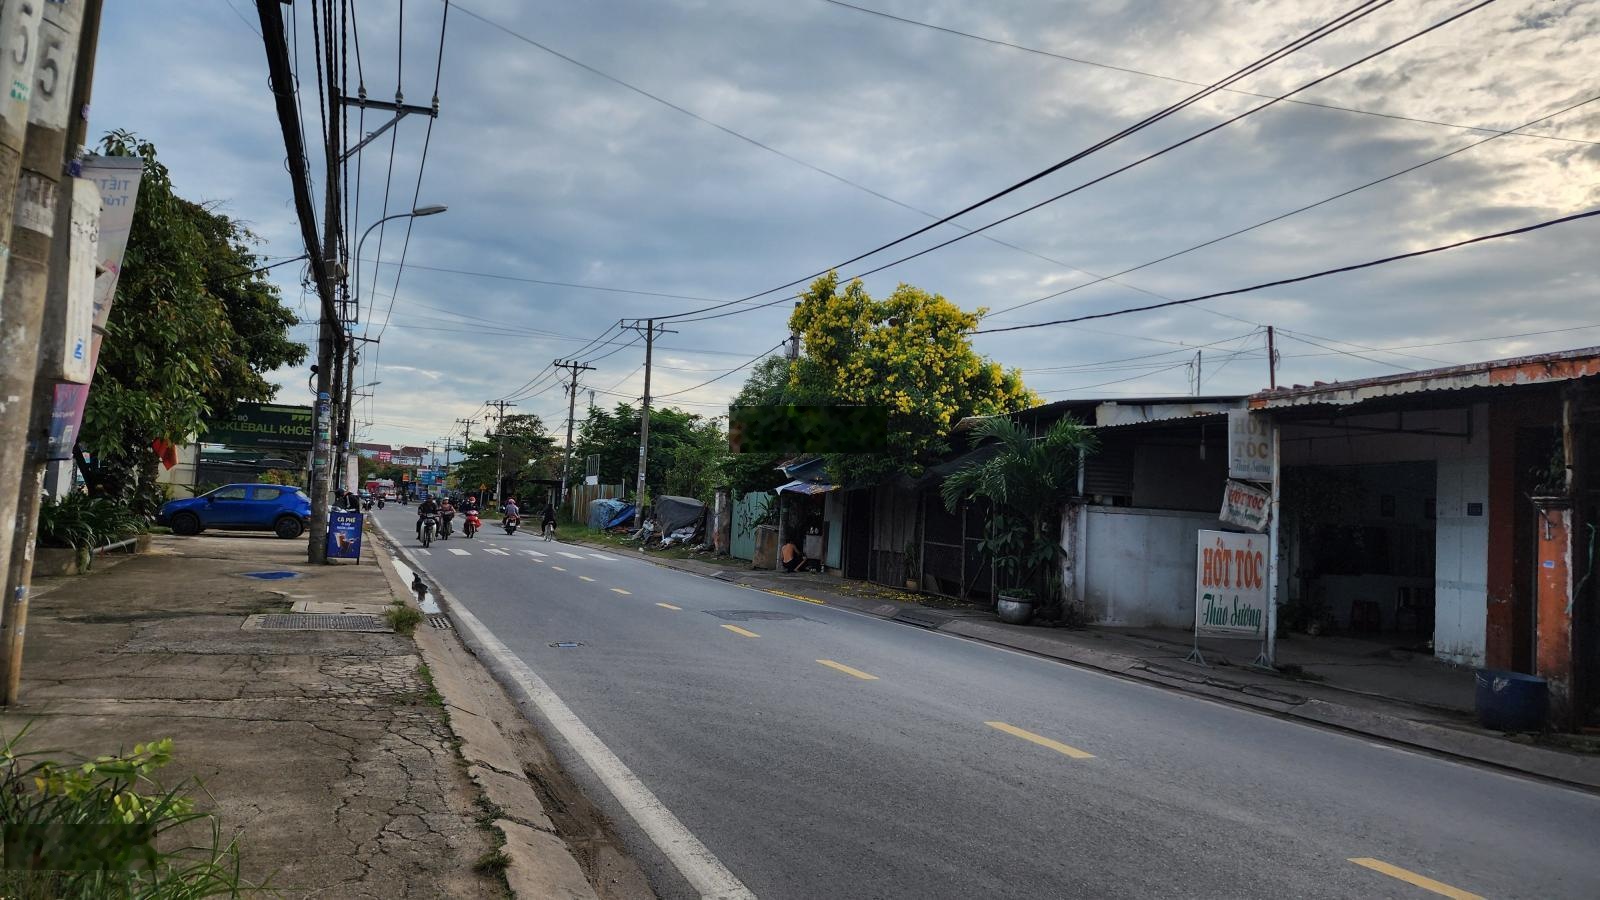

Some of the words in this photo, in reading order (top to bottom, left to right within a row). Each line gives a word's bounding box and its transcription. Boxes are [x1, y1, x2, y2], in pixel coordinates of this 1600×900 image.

[38, 36, 61, 98] 5
[1202, 537, 1232, 590] HỚT
[1235, 539, 1263, 591] TÓC
[1202, 593, 1228, 627] Thảo
[1230, 594, 1262, 634] Sương
